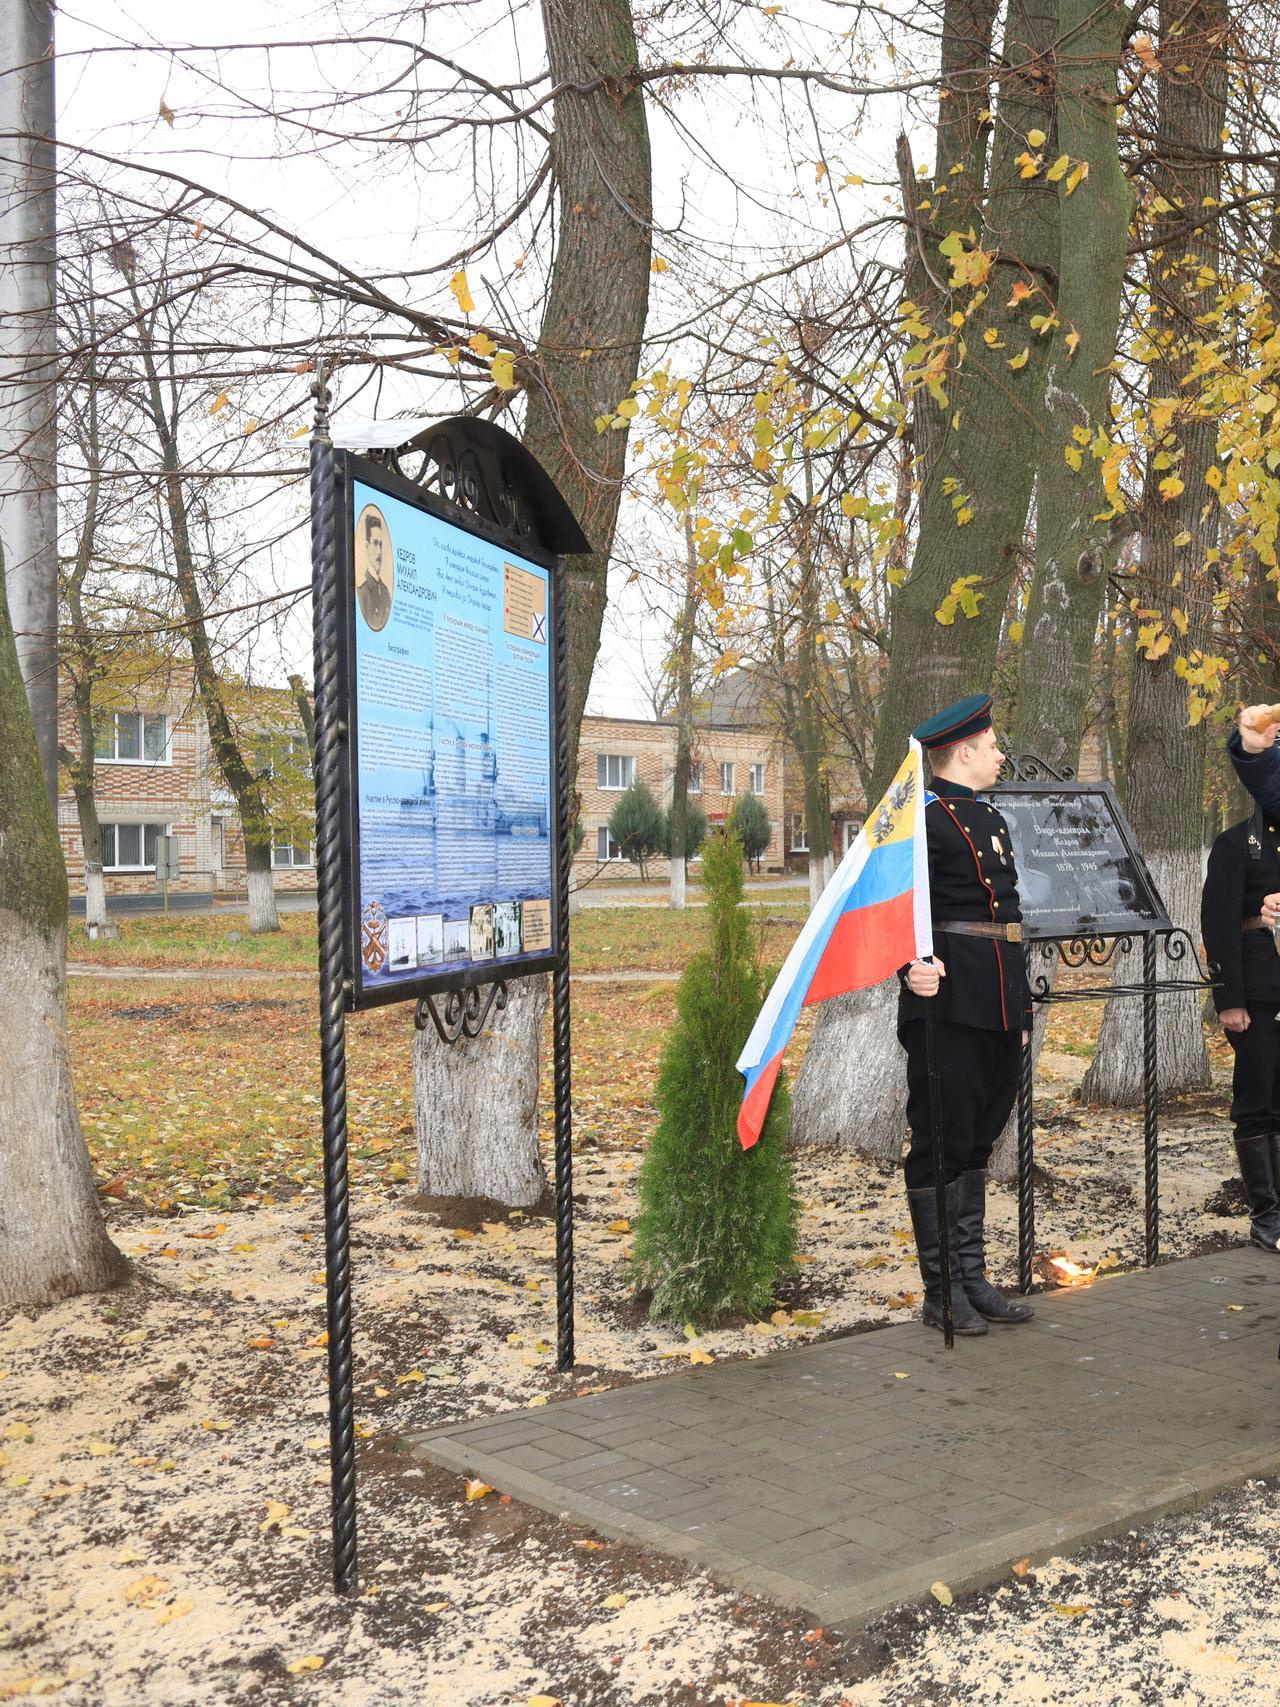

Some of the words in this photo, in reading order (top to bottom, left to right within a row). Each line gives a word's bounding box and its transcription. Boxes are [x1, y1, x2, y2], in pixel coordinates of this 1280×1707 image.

[397, 548, 416, 565] КЕДРОВ
[397, 563, 417, 579] МИХАИЛ
[397, 579, 437, 602] АЛЕКСАНДРОВИЧ
[1033, 824, 1091, 836] Вице-адмирал
[1054, 837, 1079, 847] Кедров
[1031, 849, 1060, 858] Михаил
[1061, 848, 1112, 859] Александрович
[1081, 862, 1098, 871] 1945
